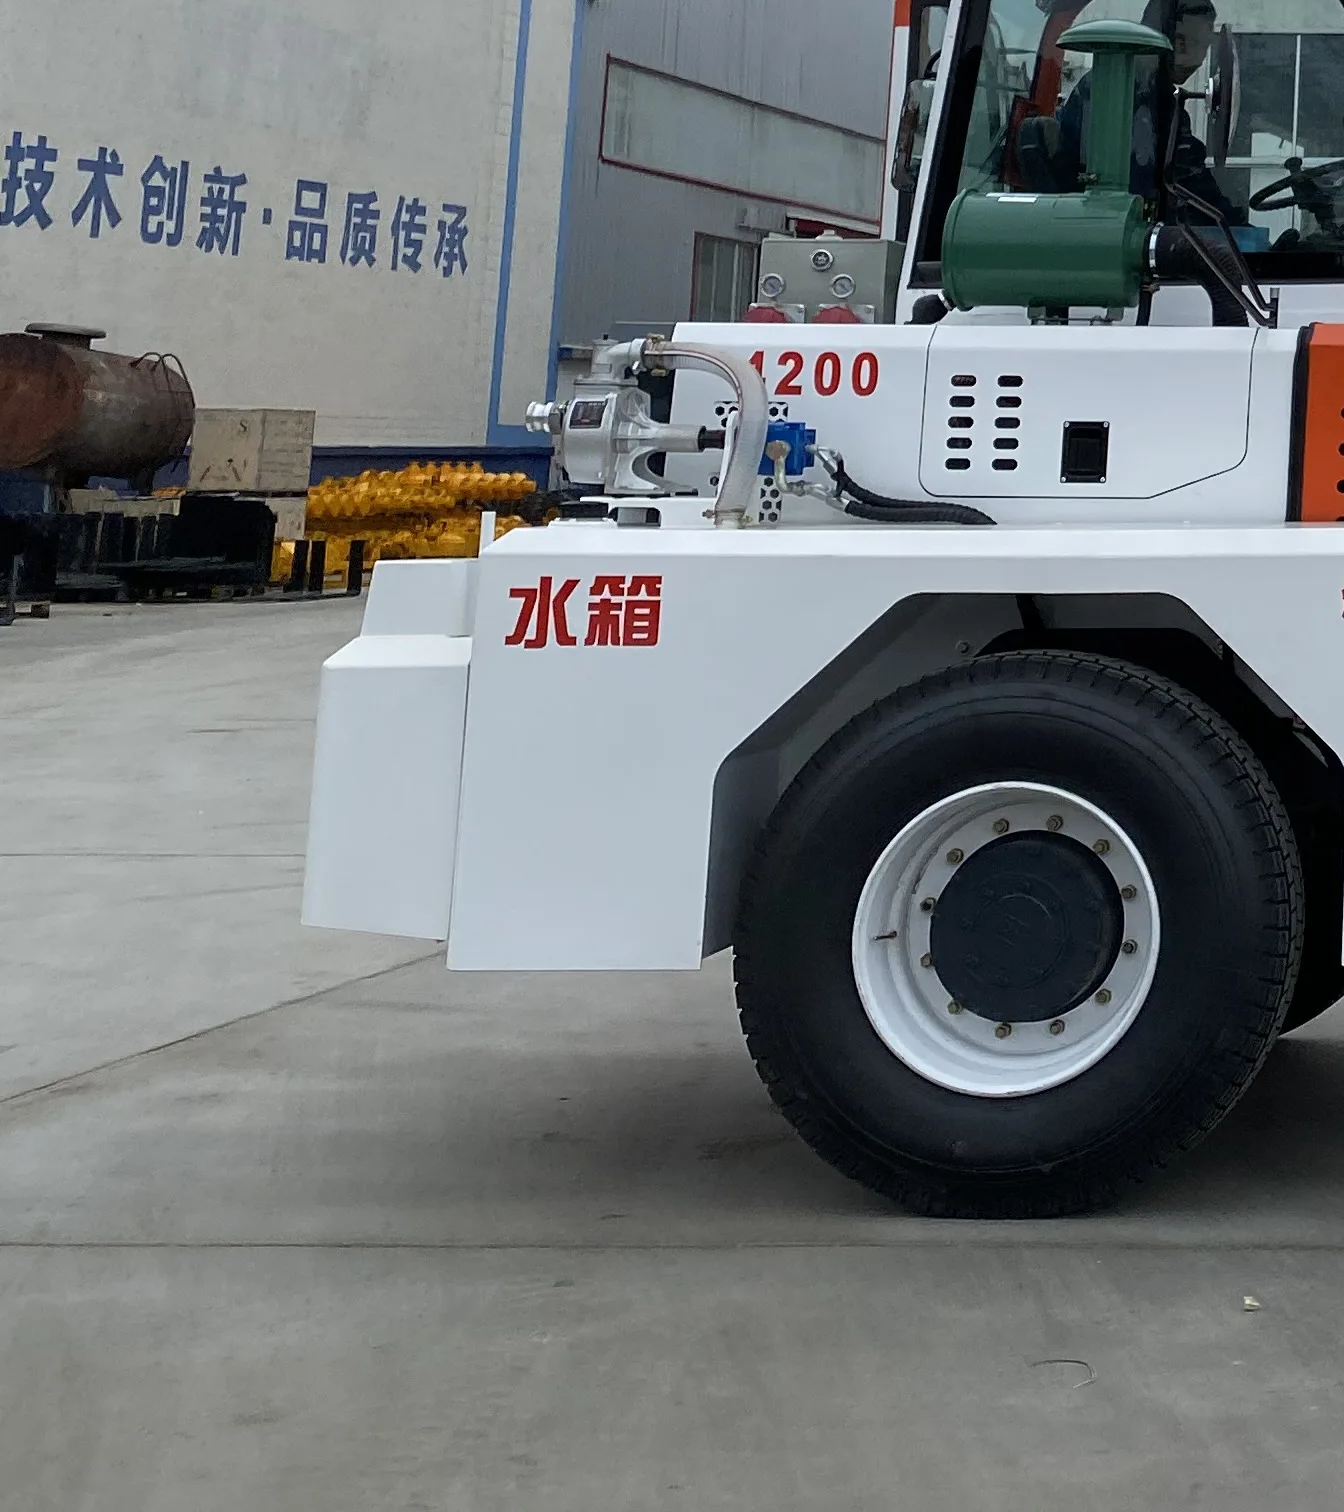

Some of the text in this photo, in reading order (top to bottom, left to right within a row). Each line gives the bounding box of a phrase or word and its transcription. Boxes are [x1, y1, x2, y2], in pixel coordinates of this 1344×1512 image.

[0, 131, 469, 278] 技术创新·品质传承
[504, 575, 663, 649] 水箱
